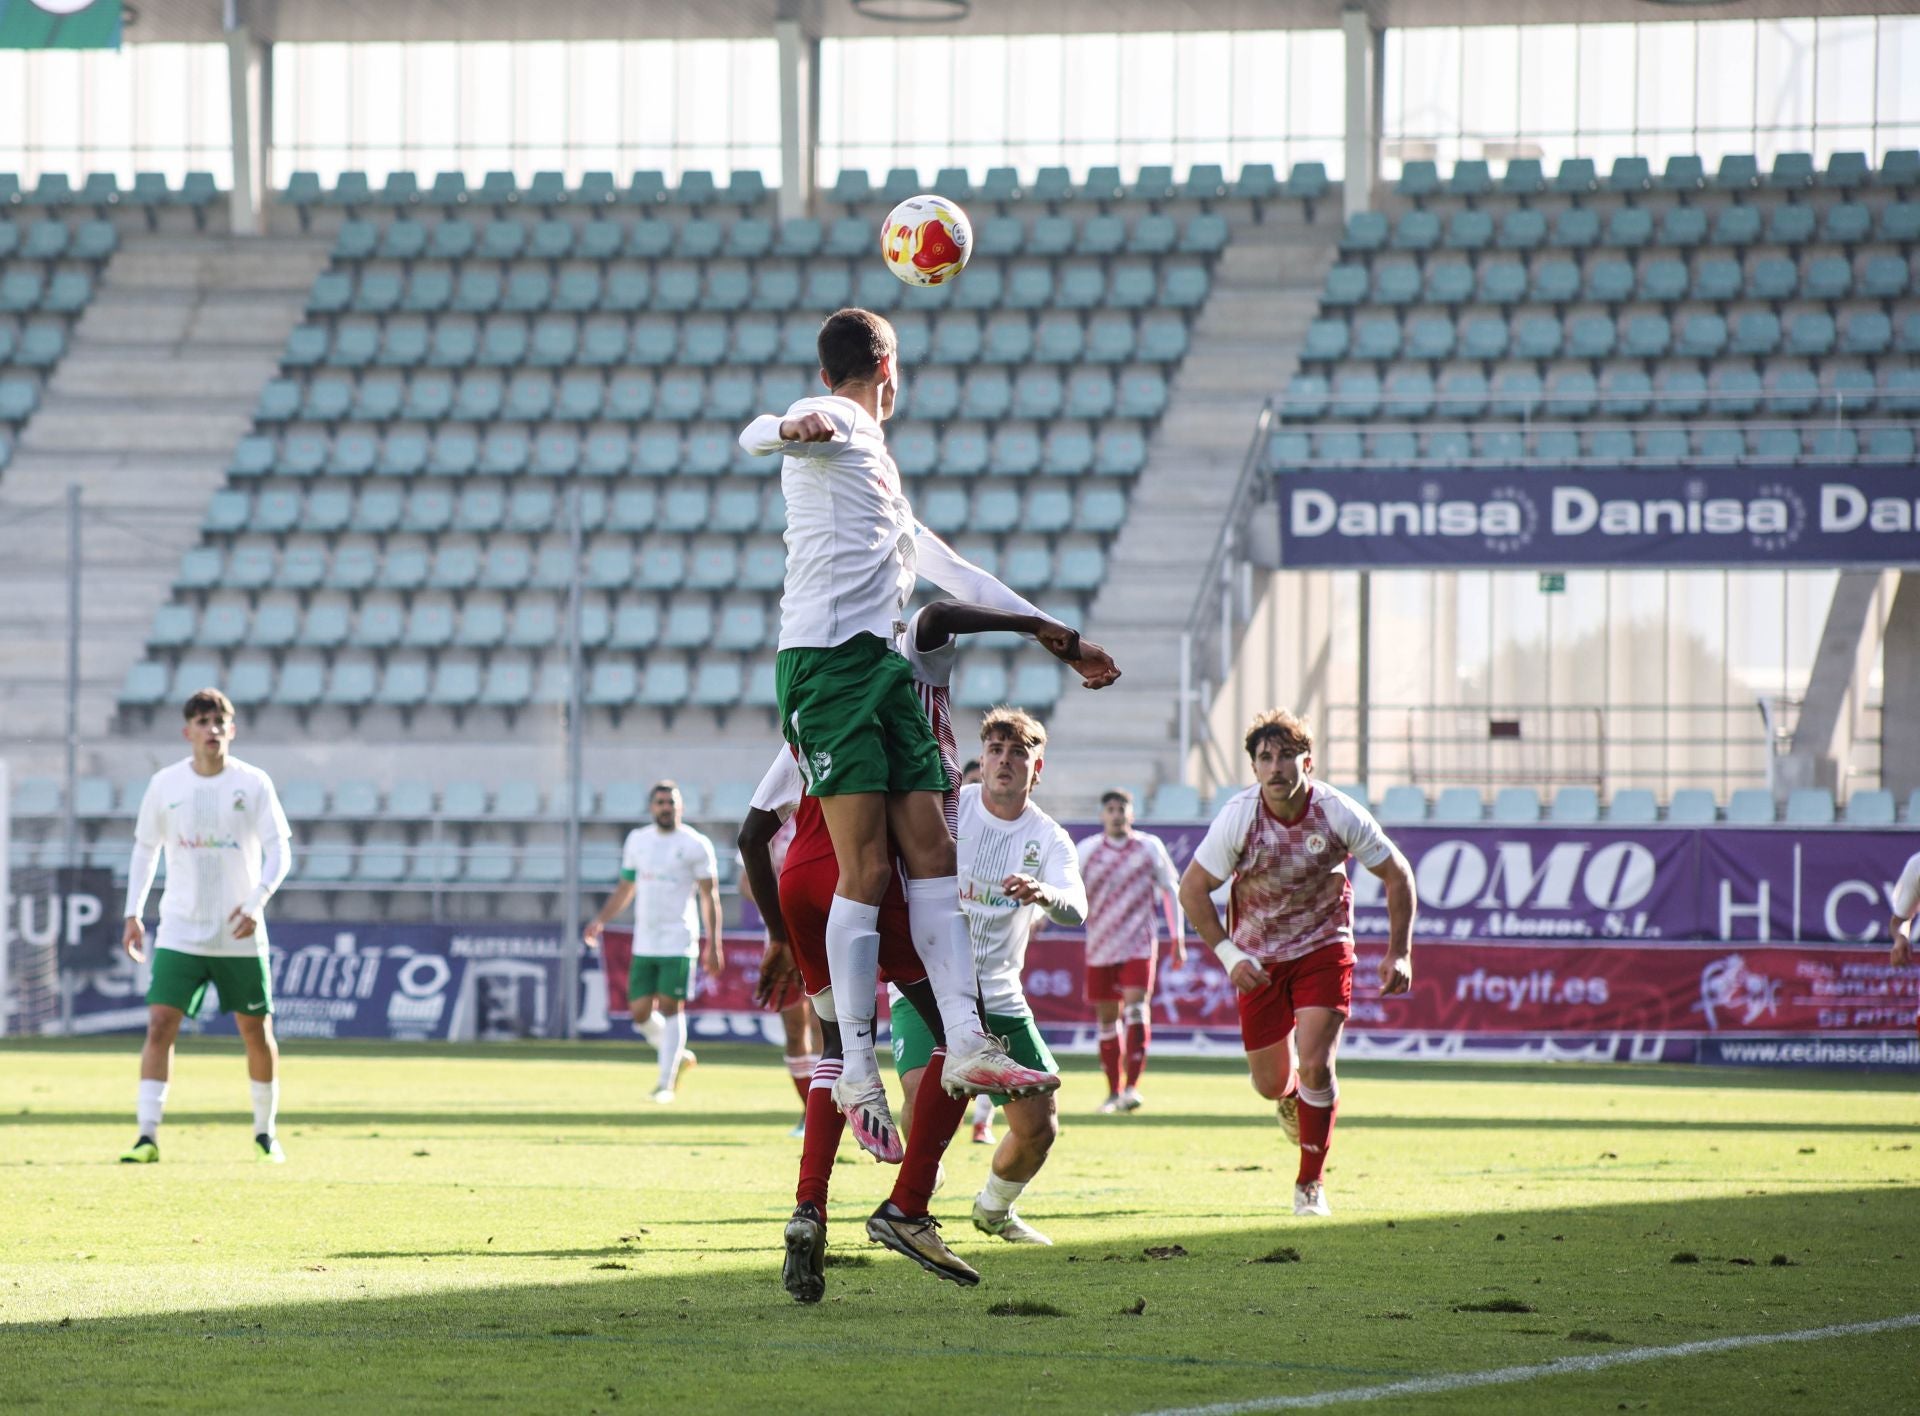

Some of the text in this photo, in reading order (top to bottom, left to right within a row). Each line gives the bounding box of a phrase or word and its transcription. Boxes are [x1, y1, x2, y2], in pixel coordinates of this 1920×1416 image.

[1290, 483, 1521, 538] Danisa
[1551, 480, 1788, 535] Danisa
[1820, 482, 1920, 534] Da
[1823, 879, 1897, 942] C
[1456, 969, 1609, 1011] rfcylf.es
